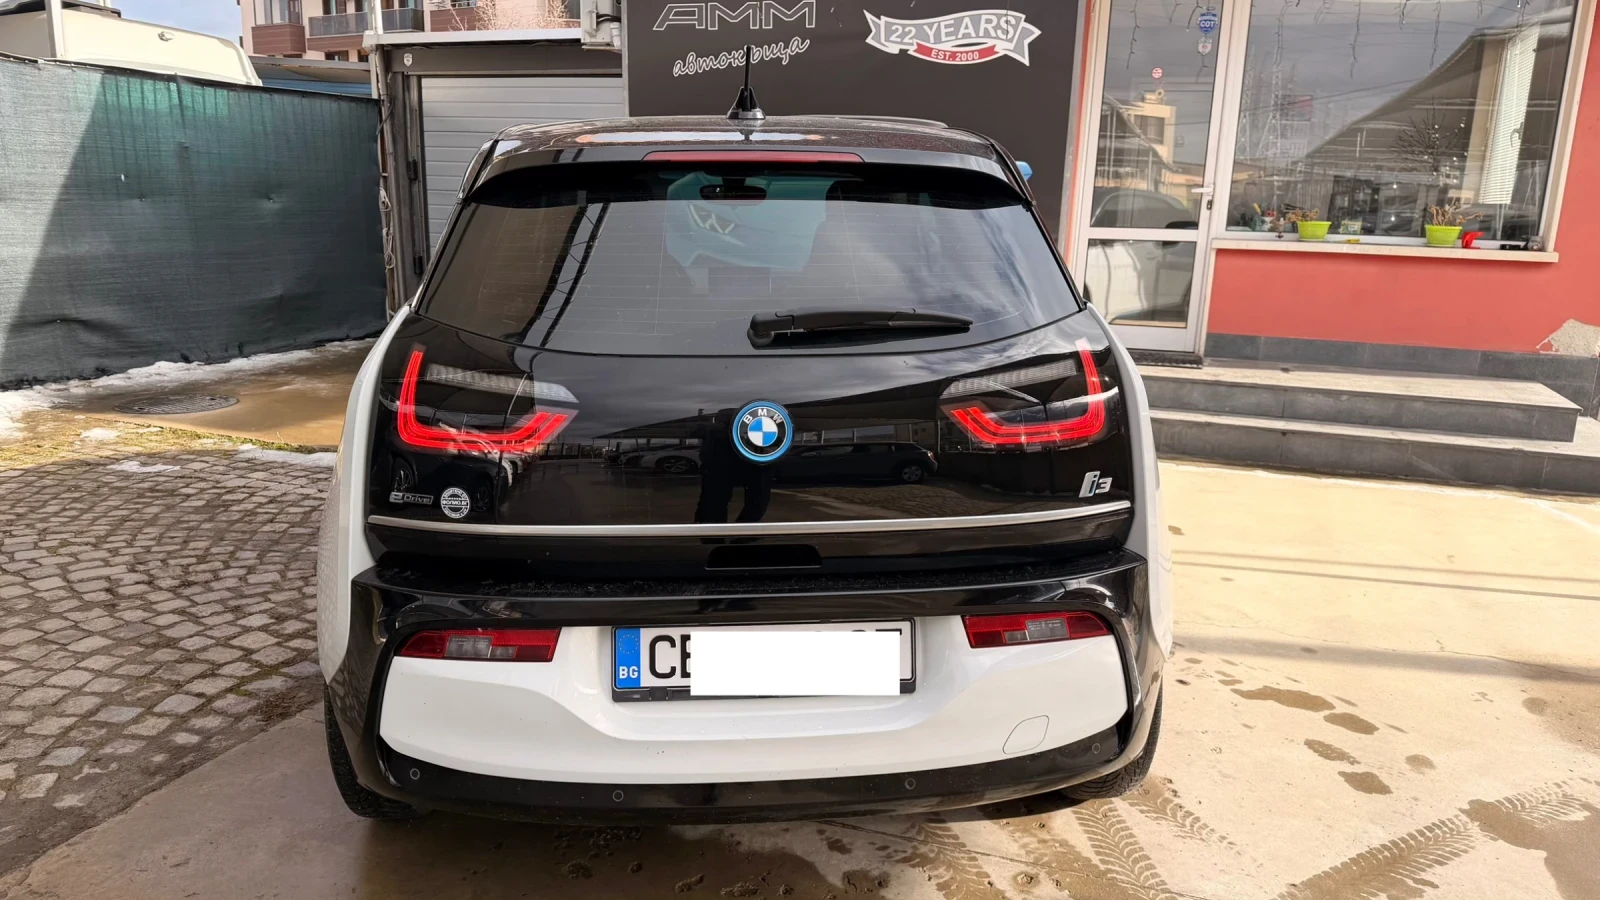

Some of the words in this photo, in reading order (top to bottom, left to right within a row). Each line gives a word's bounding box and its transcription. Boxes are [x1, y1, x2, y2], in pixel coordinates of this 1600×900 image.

[653, 0, 816, 31] AMM
[889, 25, 916, 43] 22
[922, 14, 1016, 44] YEARS
[931, 49, 953, 61] EST.
[955, 51, 979, 62] 2000
[742, 408, 783, 425] BMW
[1078, 470, 1113, 498] i3
[619, 665, 639, 679] BG
